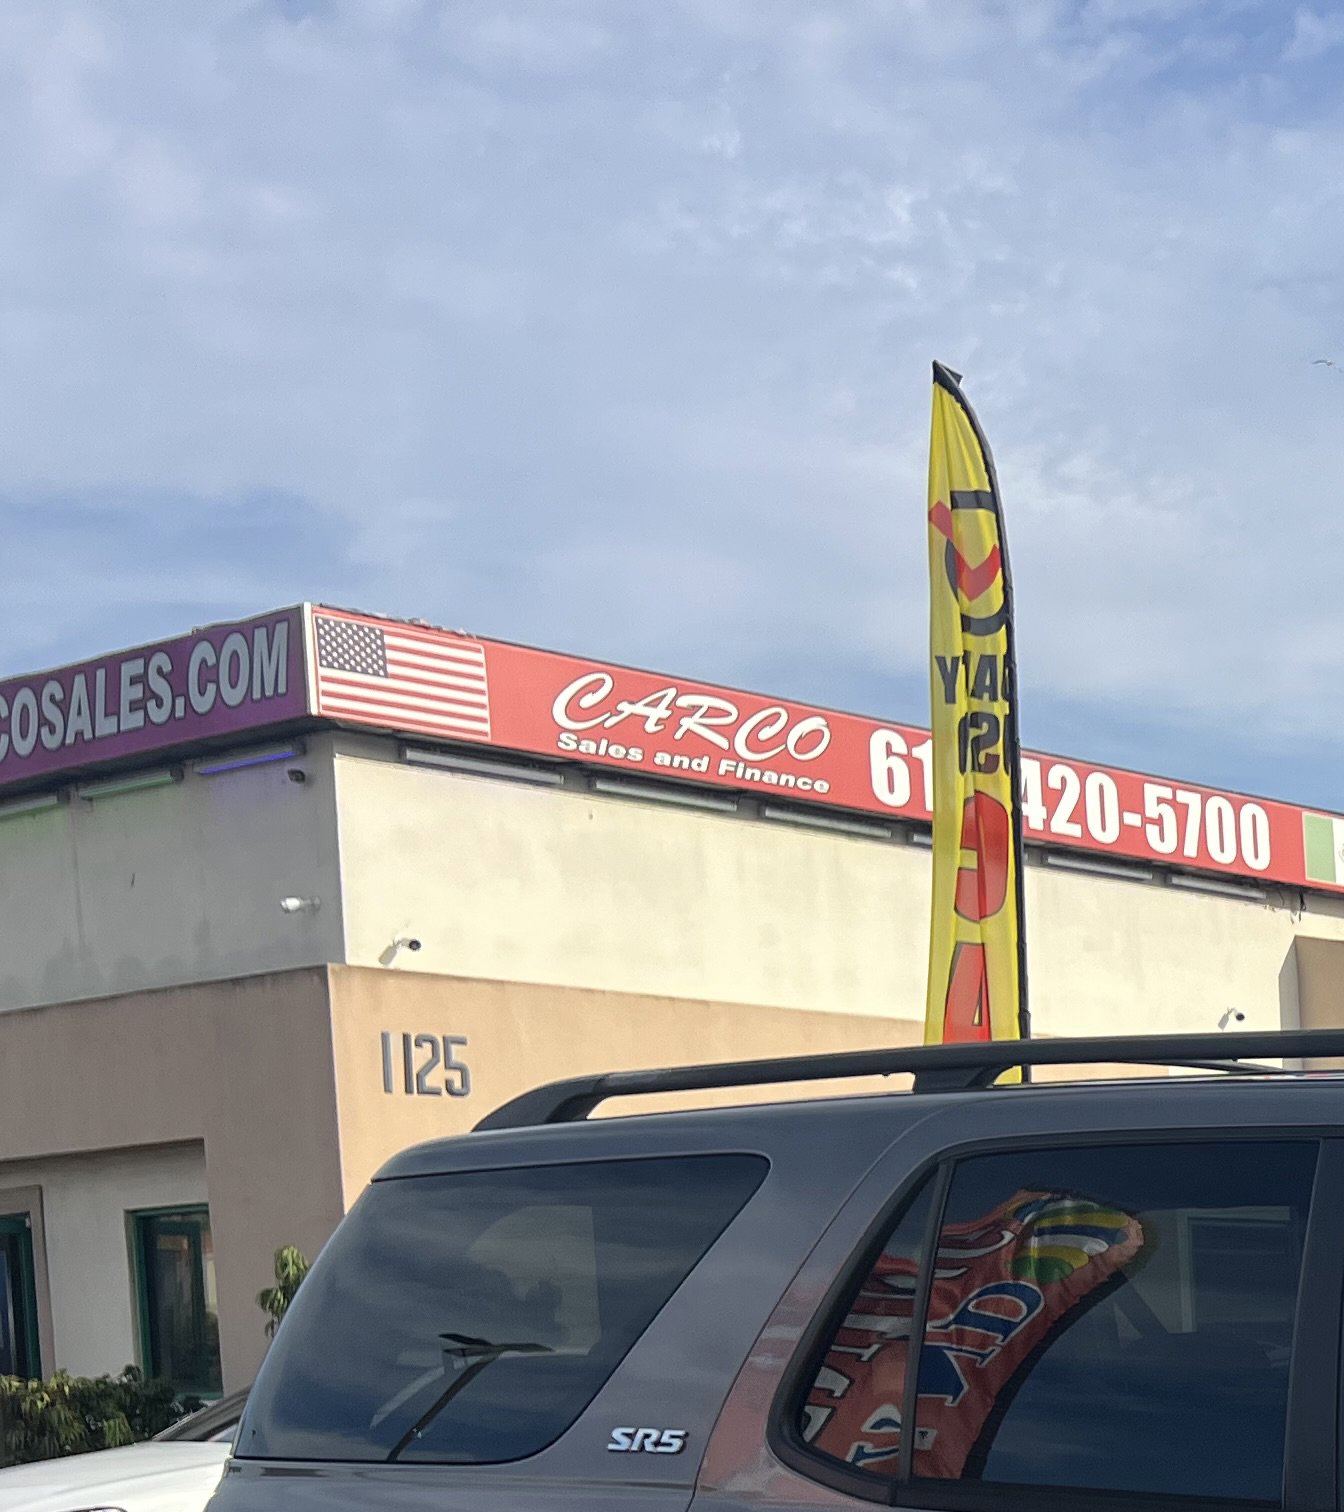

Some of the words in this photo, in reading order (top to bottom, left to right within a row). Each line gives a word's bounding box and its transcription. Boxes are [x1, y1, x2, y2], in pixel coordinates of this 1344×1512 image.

[552, 672, 831, 760] CARCO
[558, 732, 643, 761] Sales
[654, 751, 710, 773] and
[719, 759, 830, 793] Finance
[868, 728, 933, 812] 61
[380, 1032, 471, 1097] 1125
[607, 1427, 688, 1453] SR5
